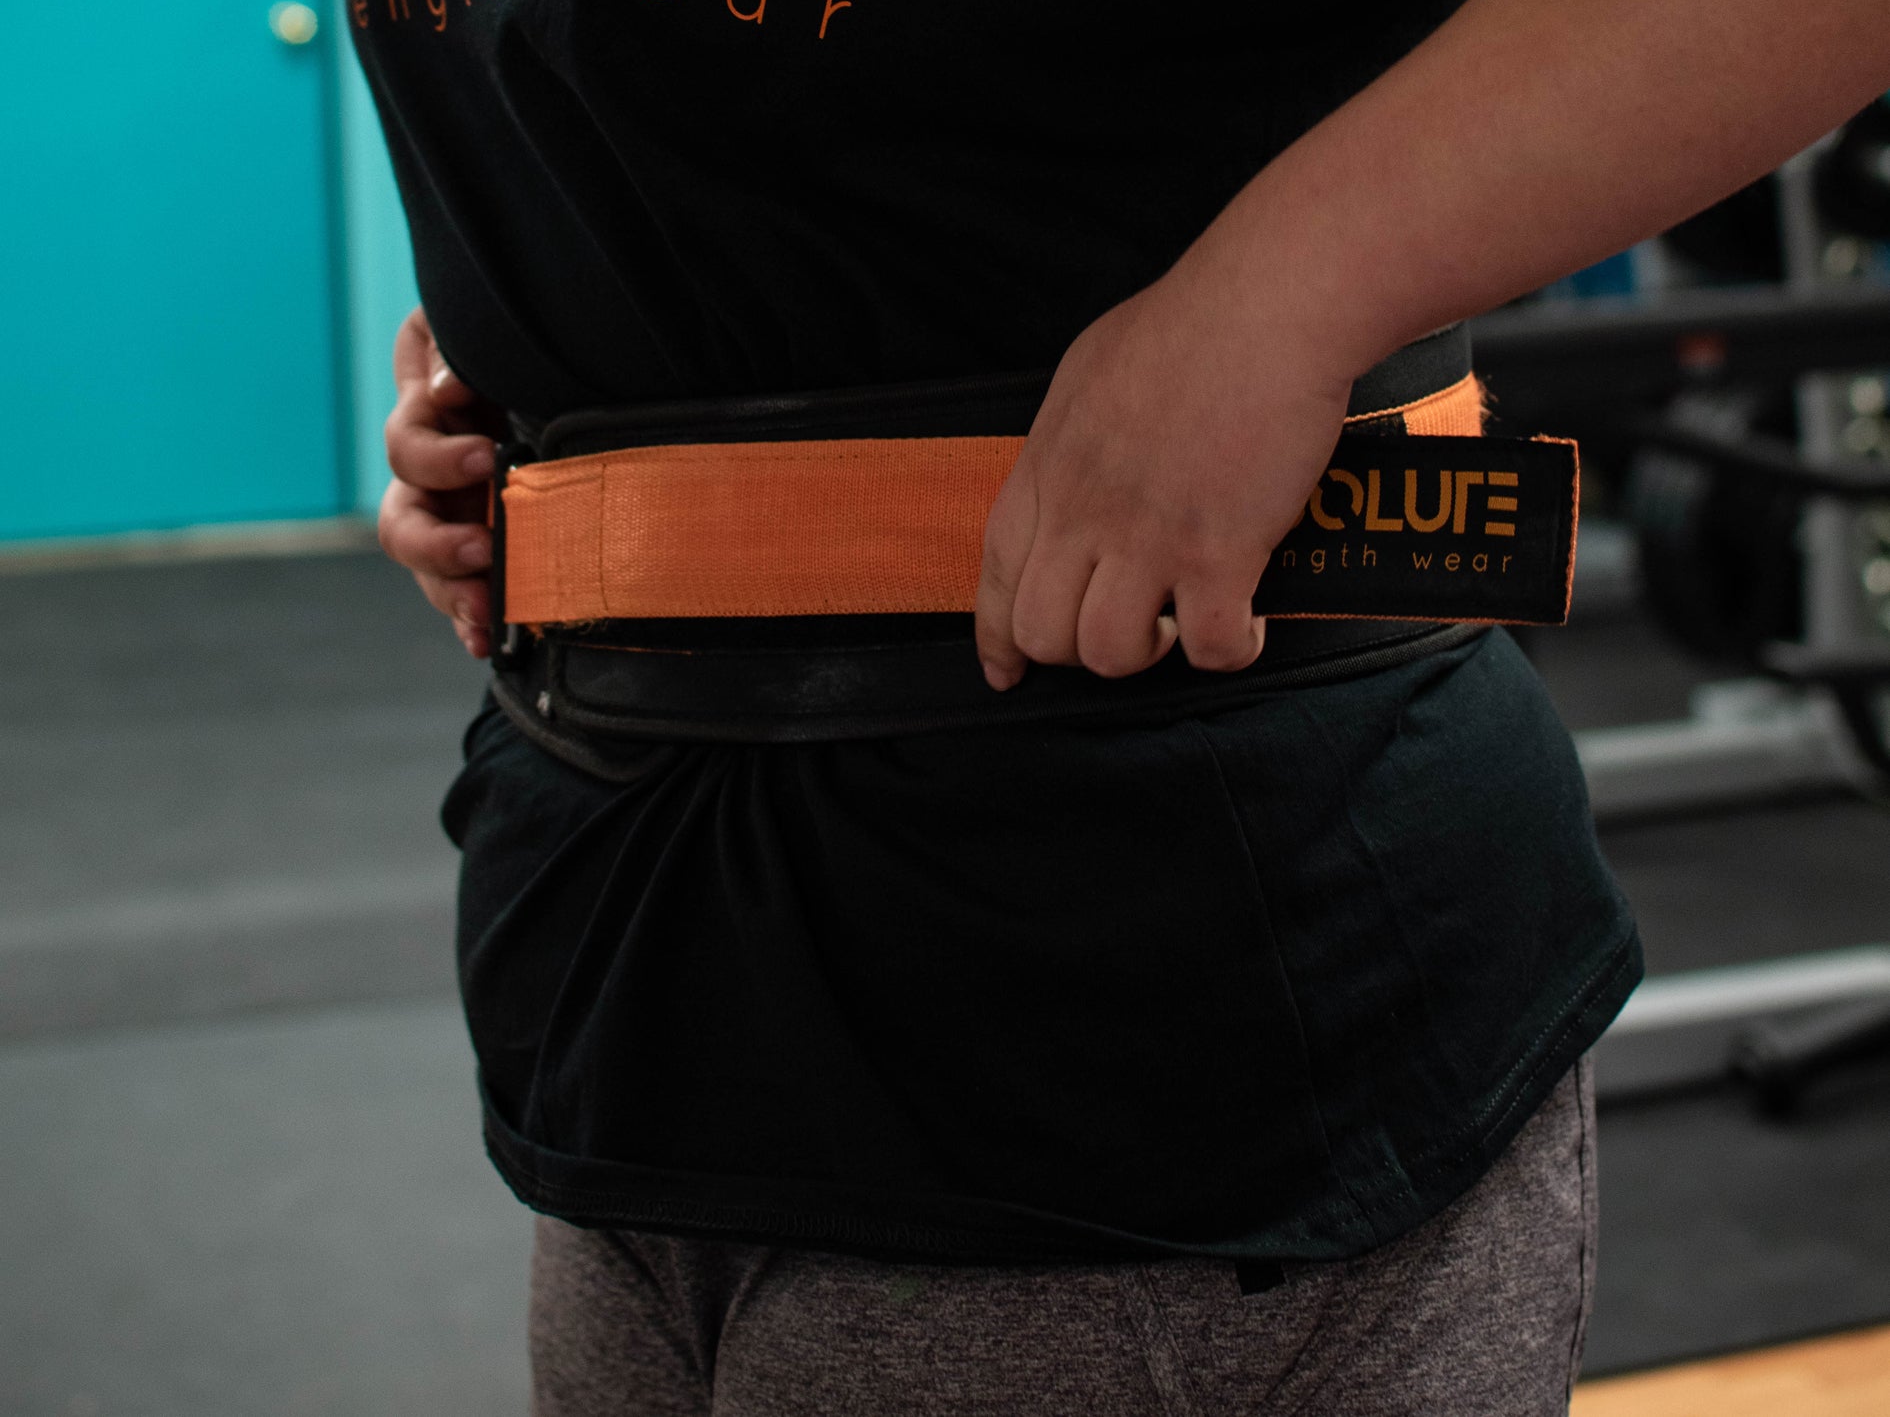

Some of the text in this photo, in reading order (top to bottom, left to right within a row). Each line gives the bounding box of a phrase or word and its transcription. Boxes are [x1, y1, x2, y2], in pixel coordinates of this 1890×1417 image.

[1295, 468, 1518, 536] OLUTE
[1283, 542, 1512, 573] ngth wear
